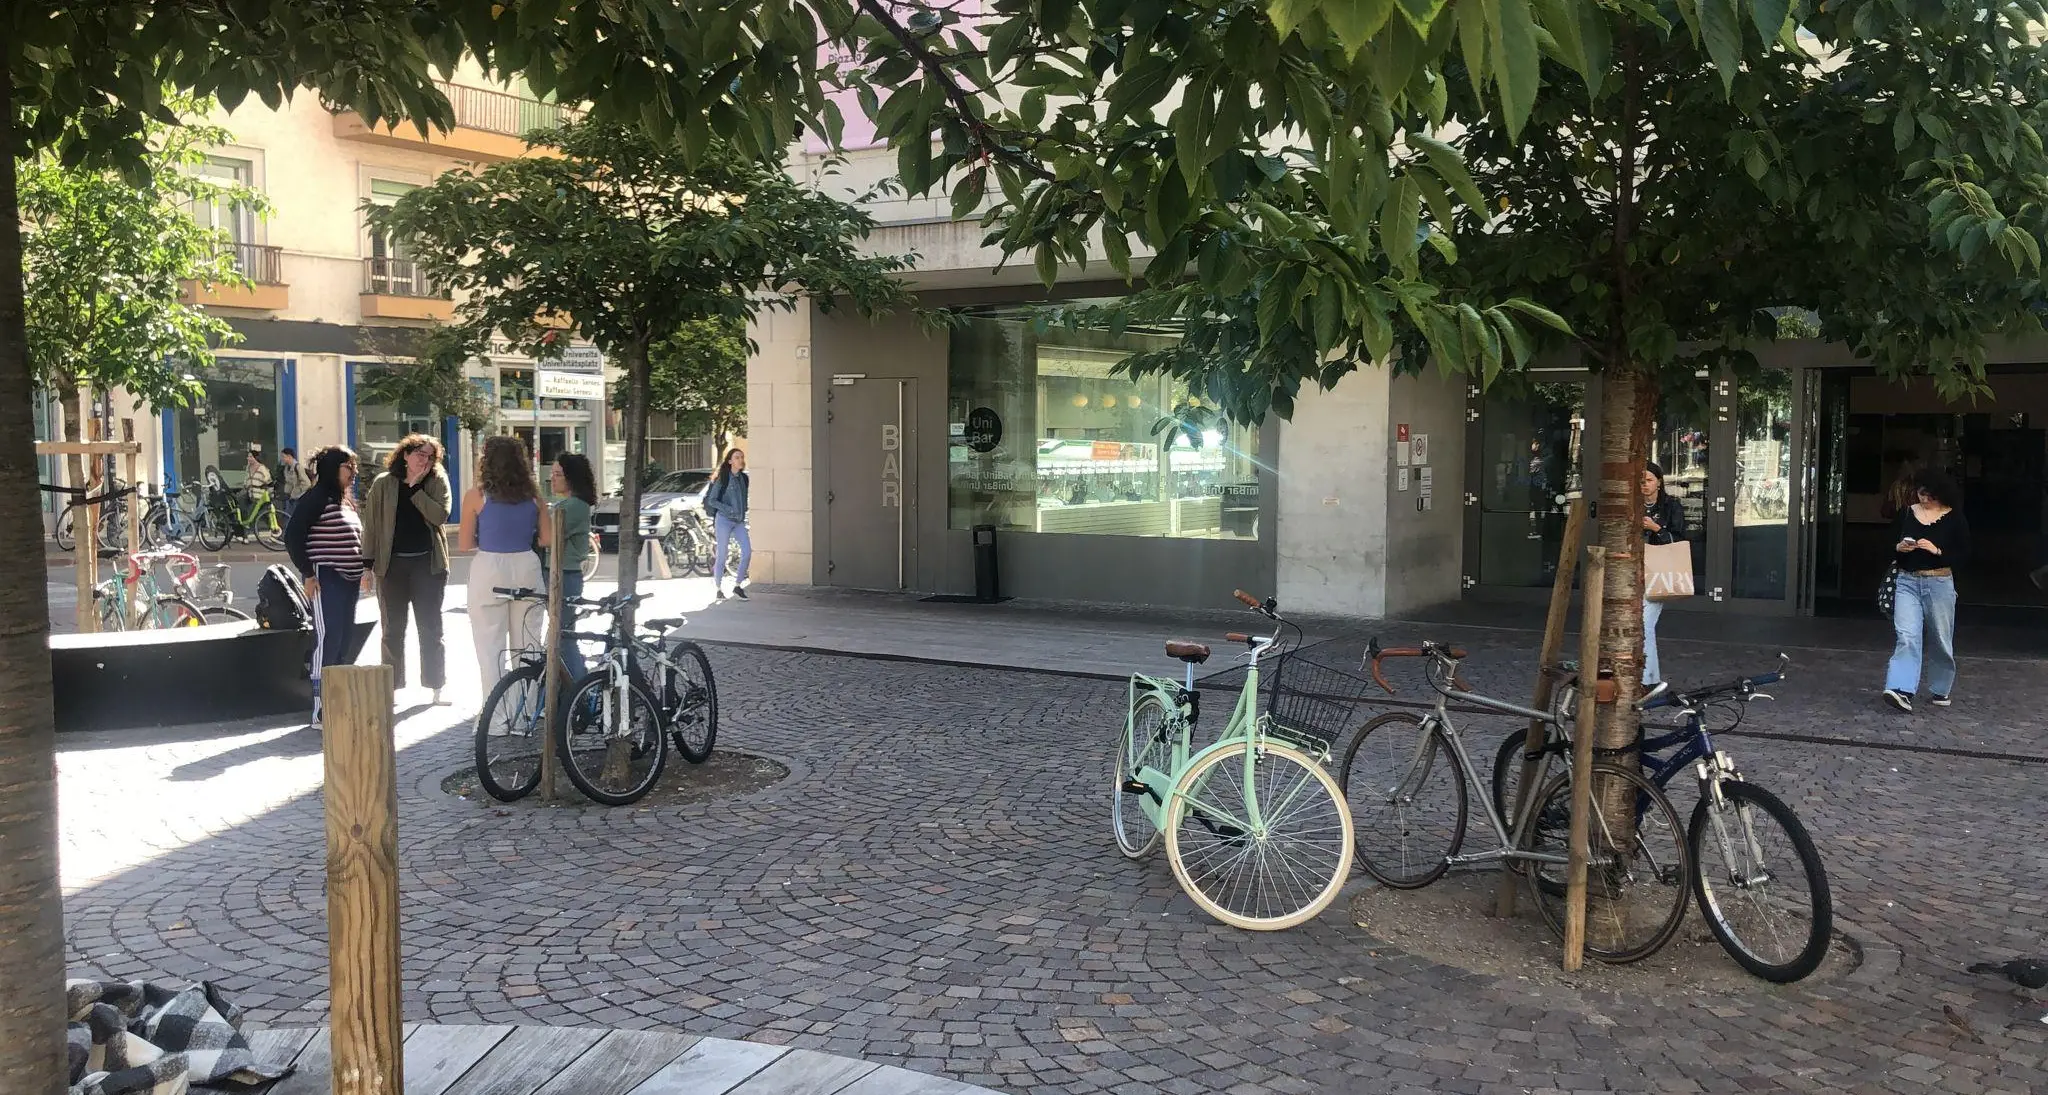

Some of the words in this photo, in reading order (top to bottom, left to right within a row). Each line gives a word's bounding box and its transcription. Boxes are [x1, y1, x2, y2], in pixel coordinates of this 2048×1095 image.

[972, 416, 993, 429] Uni
[972, 431, 994, 443] Bar
[882, 424, 899, 507] BAR
